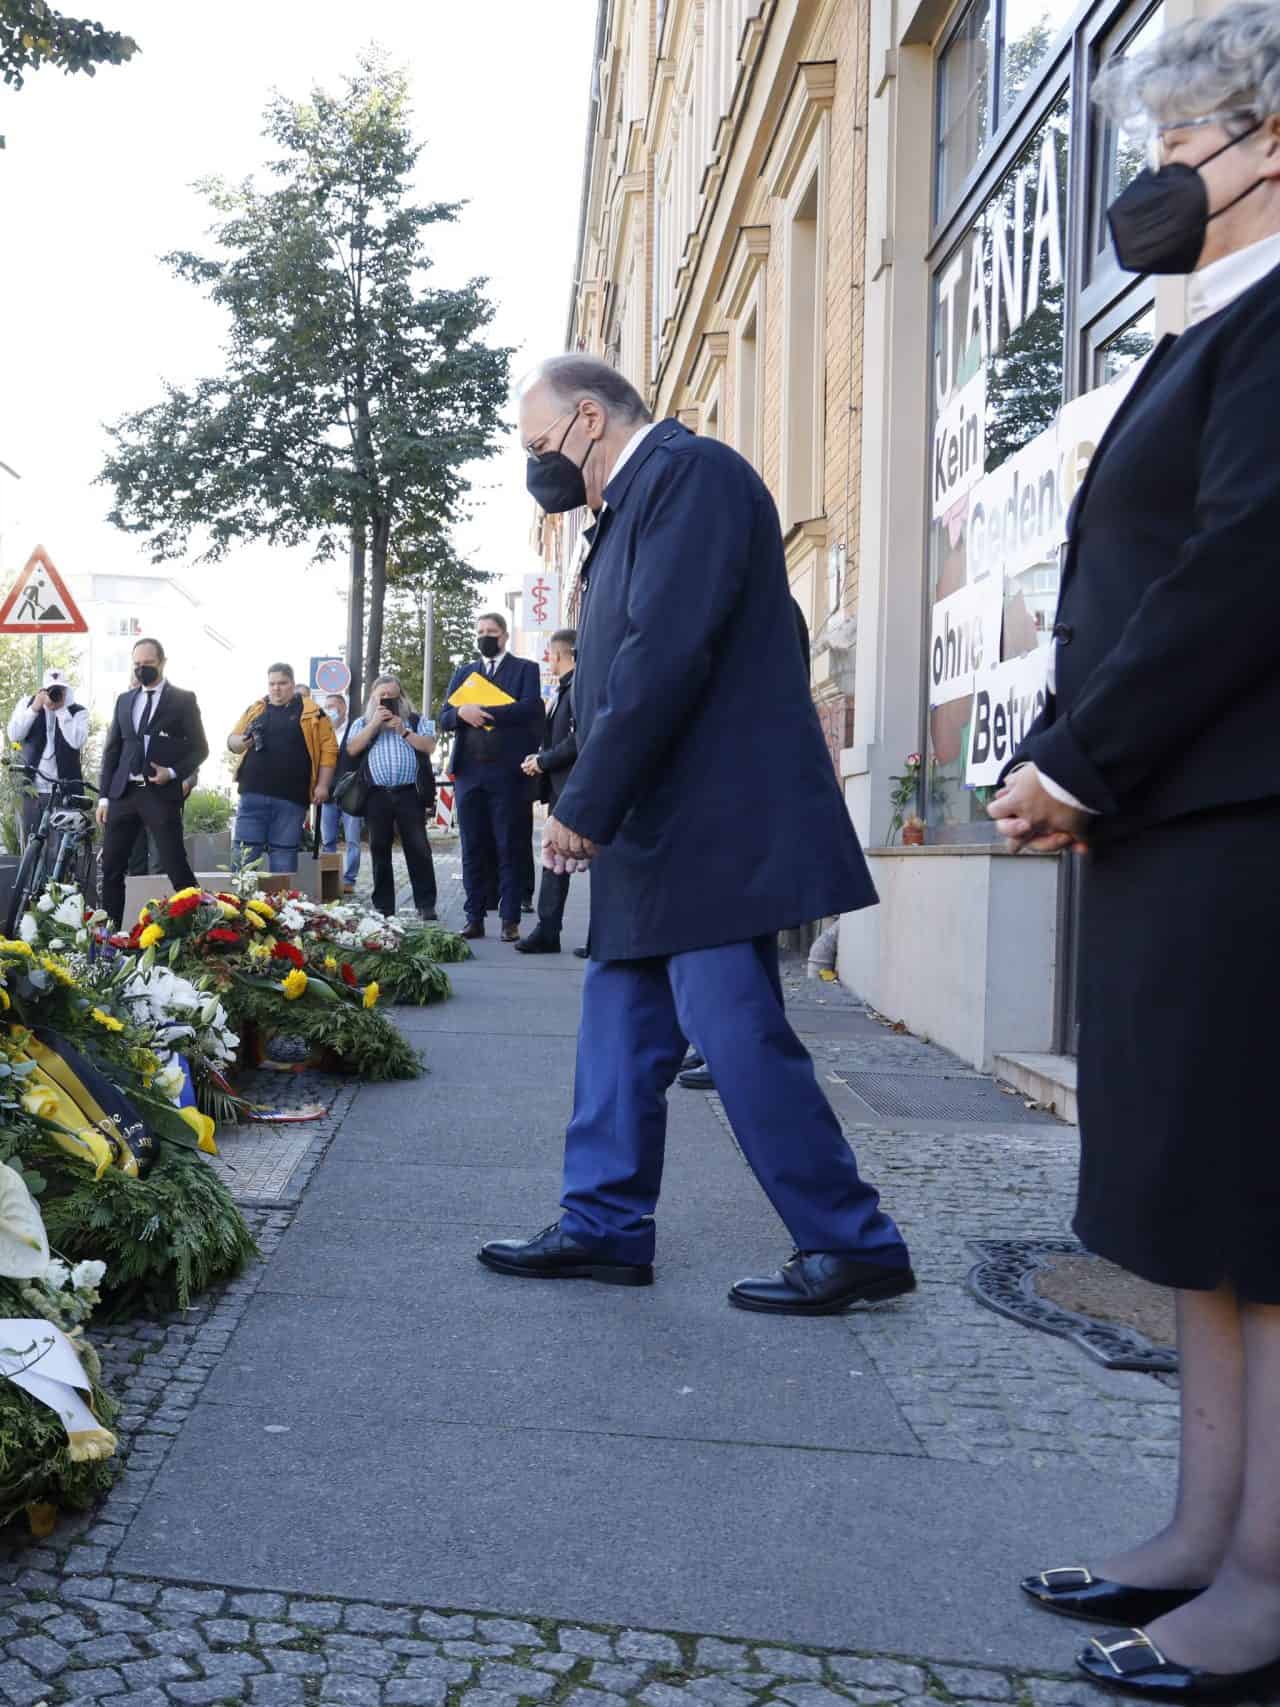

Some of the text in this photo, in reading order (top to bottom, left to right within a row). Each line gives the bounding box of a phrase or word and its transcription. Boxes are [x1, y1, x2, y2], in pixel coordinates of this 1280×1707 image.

[935, 126, 1065, 405] JANA
[935, 404, 978, 502] Kein
[933, 611, 984, 687] ohne
